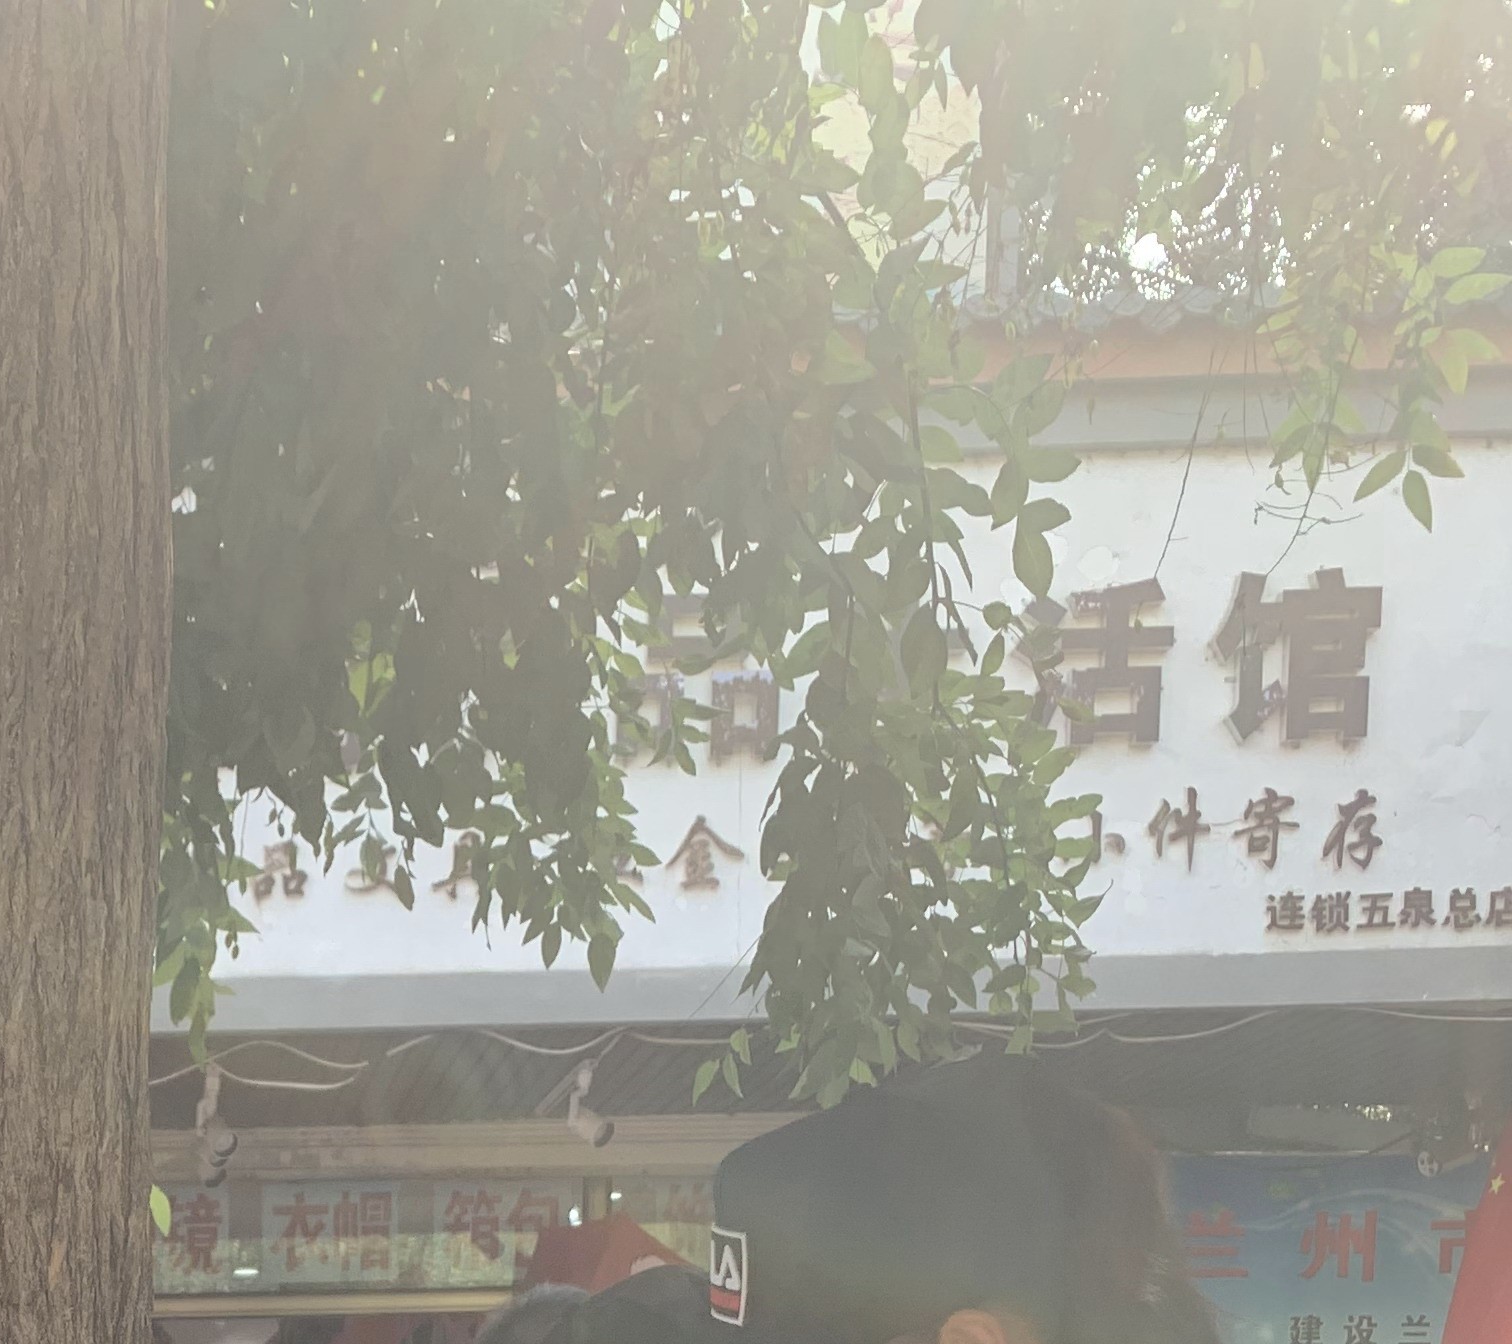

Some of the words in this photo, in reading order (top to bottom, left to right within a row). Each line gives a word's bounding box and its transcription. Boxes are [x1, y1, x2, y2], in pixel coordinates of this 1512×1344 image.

[1265, 886, 1512, 933] 连锁五泉总店
[270, 1190, 393, 1274] 衣帽
